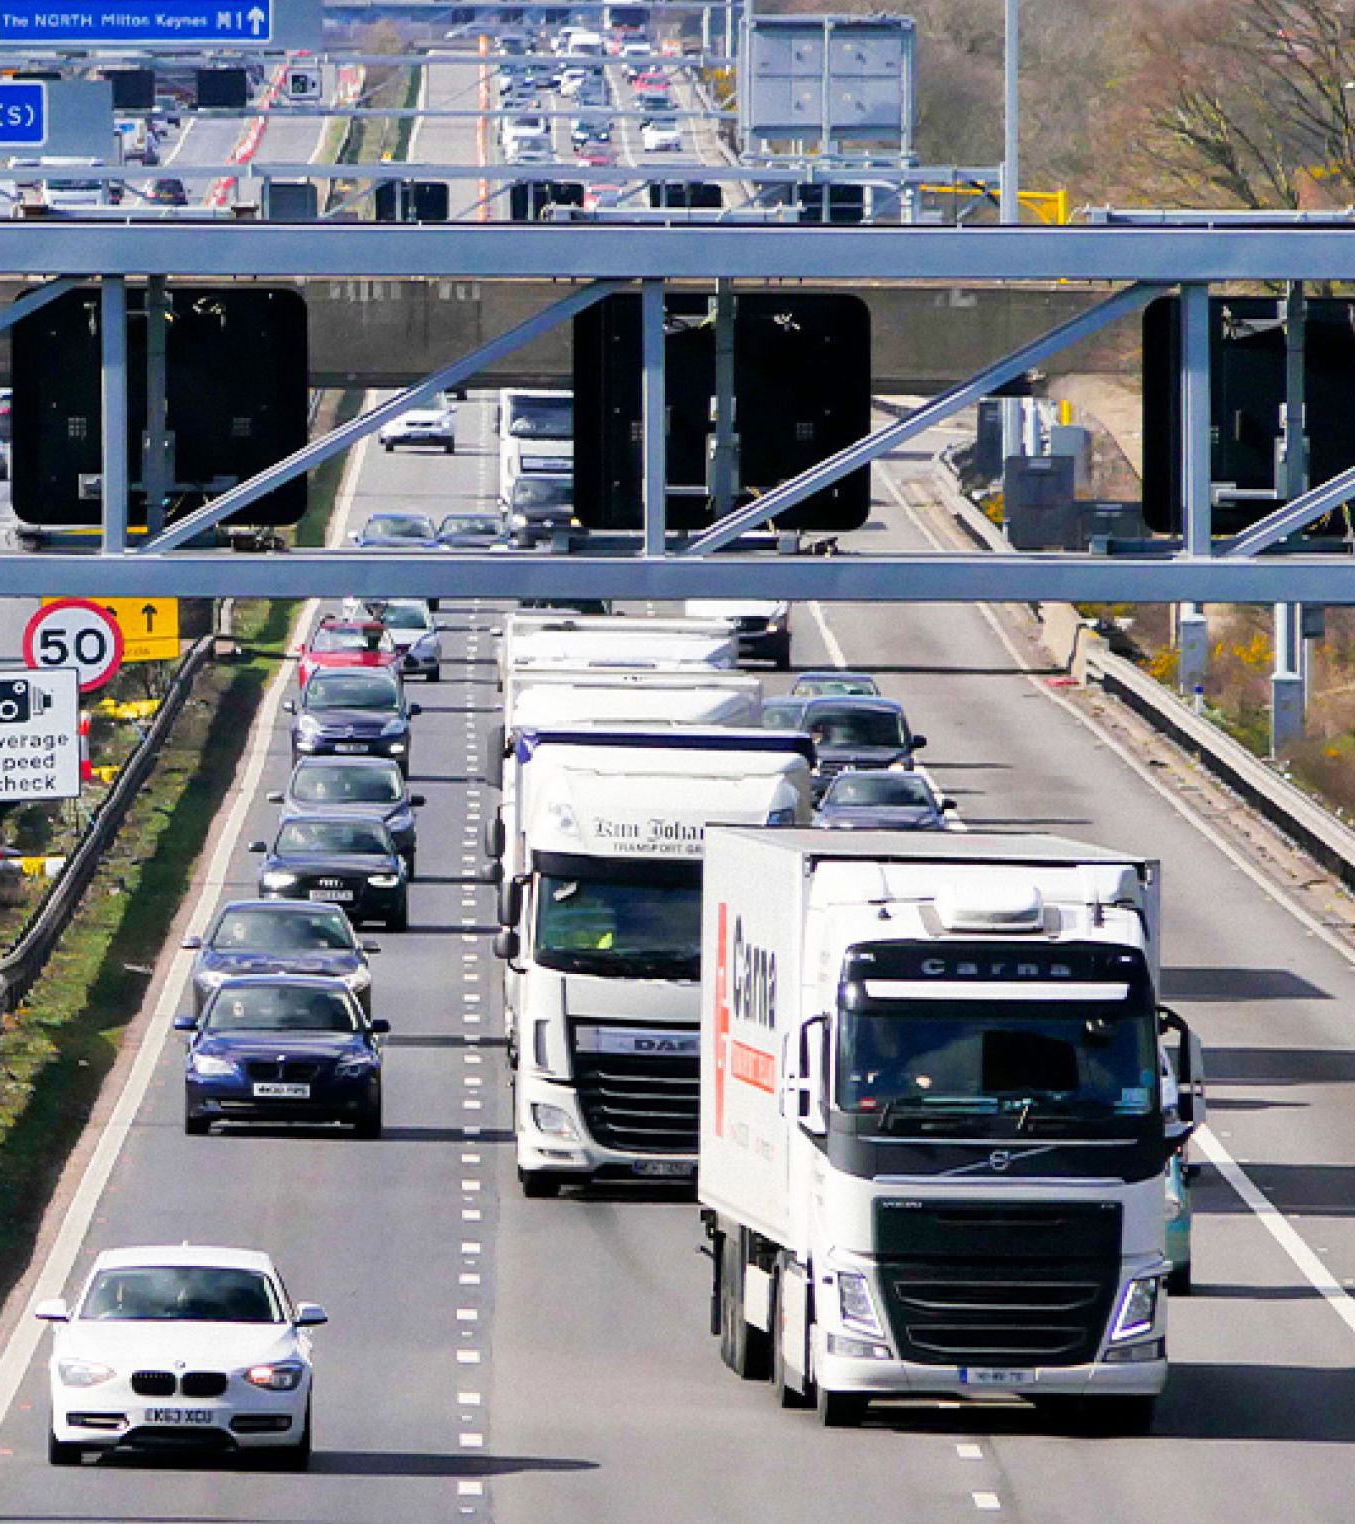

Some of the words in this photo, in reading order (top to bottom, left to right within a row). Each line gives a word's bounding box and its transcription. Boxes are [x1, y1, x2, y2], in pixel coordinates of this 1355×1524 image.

[3, 13, 29, 27] The
[39, 627, 108, 666] 50
[922, 958, 1071, 975] Carna
